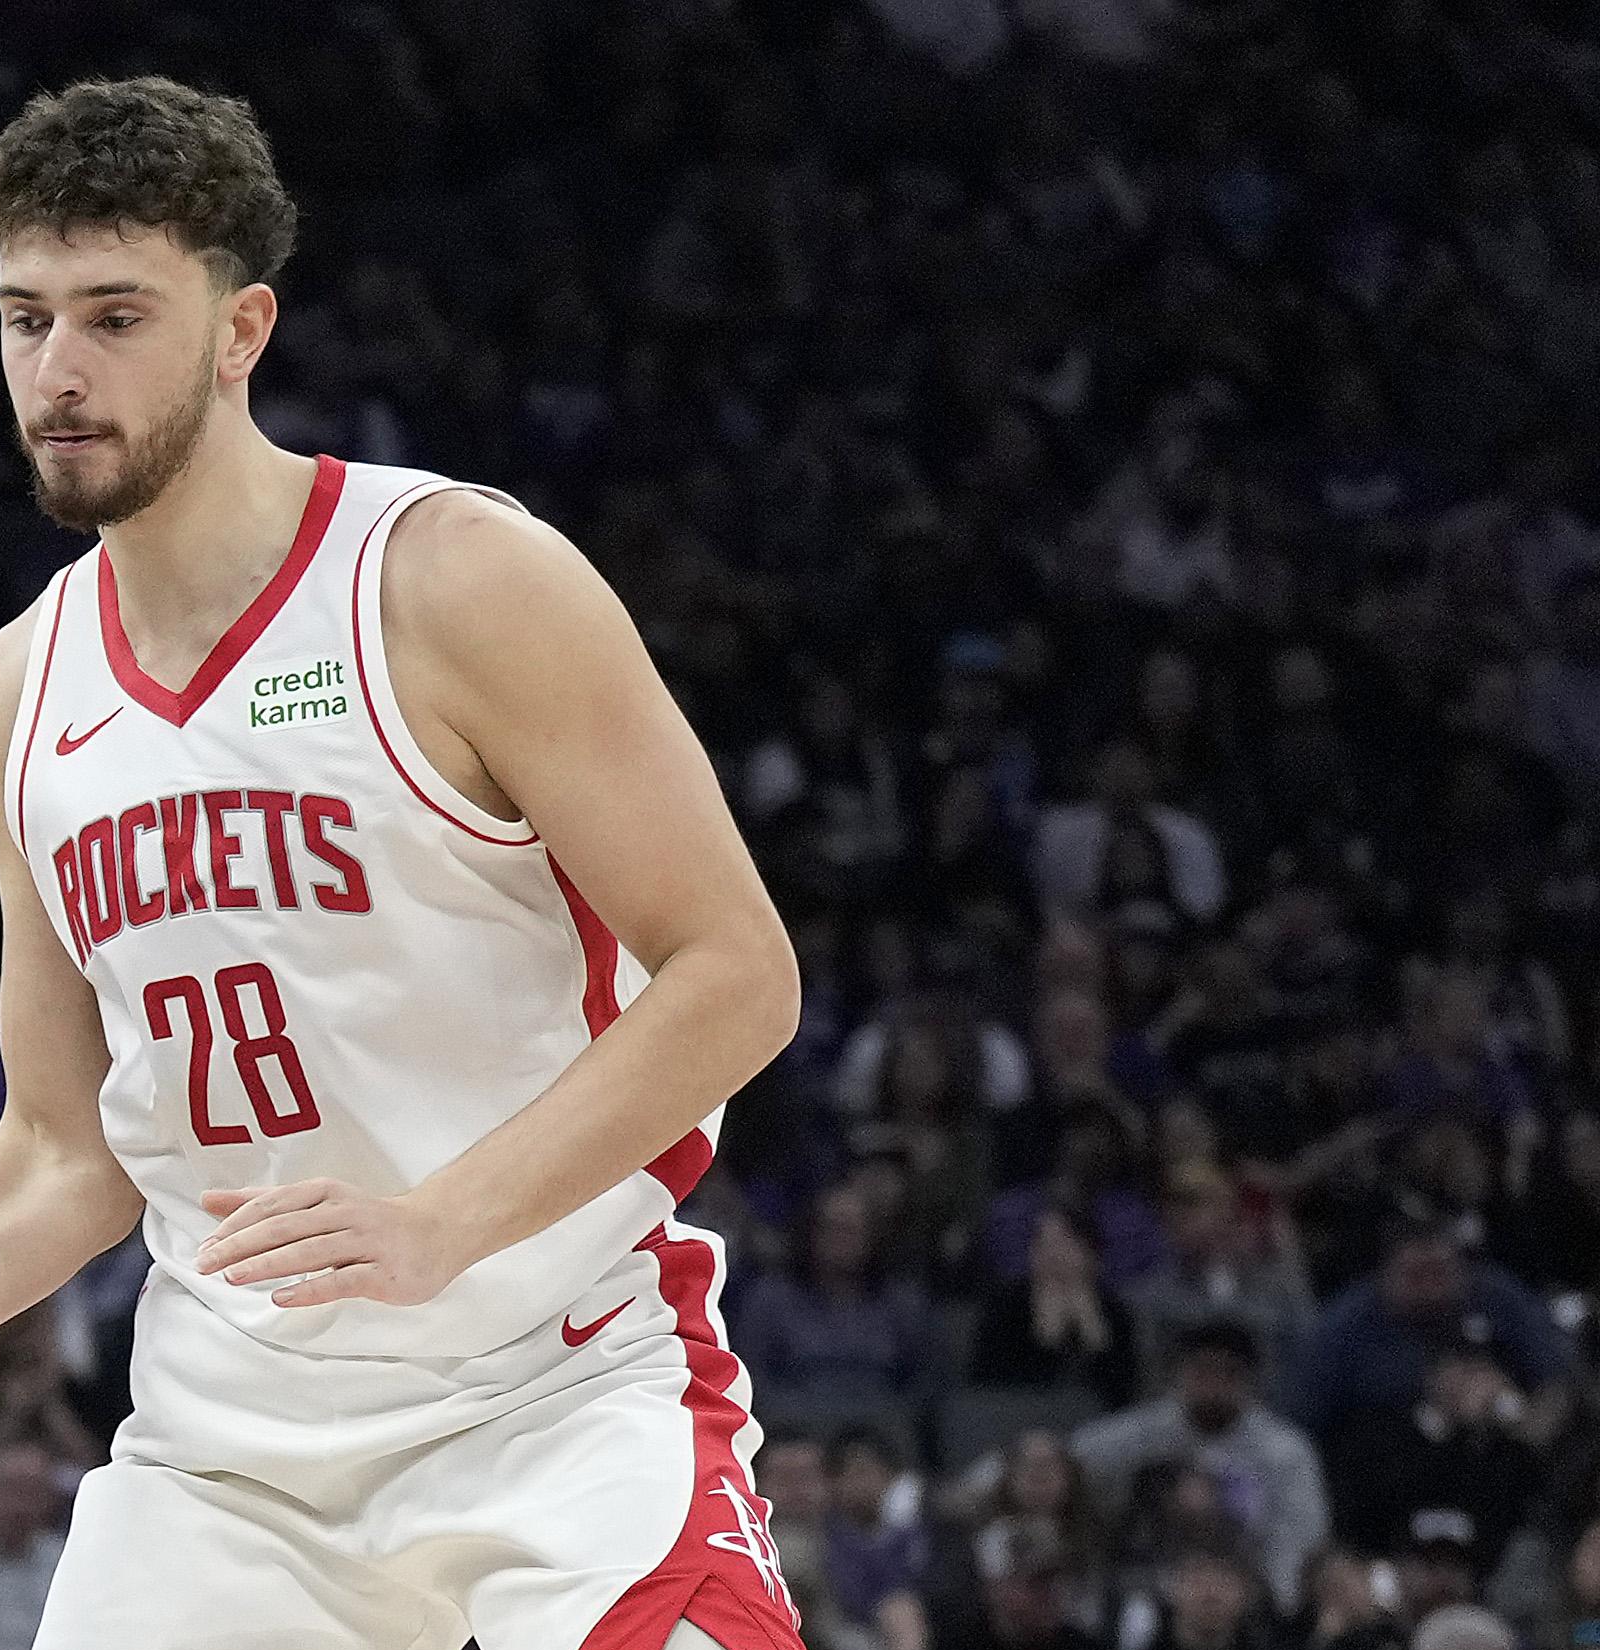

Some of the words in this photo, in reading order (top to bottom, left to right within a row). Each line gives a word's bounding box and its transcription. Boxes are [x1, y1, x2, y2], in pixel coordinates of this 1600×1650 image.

[250, 695, 347, 728] karma
[254, 660, 345, 697] credit
[52, 787, 375, 974] ROCKETS
[142, 962, 322, 1147] 28
